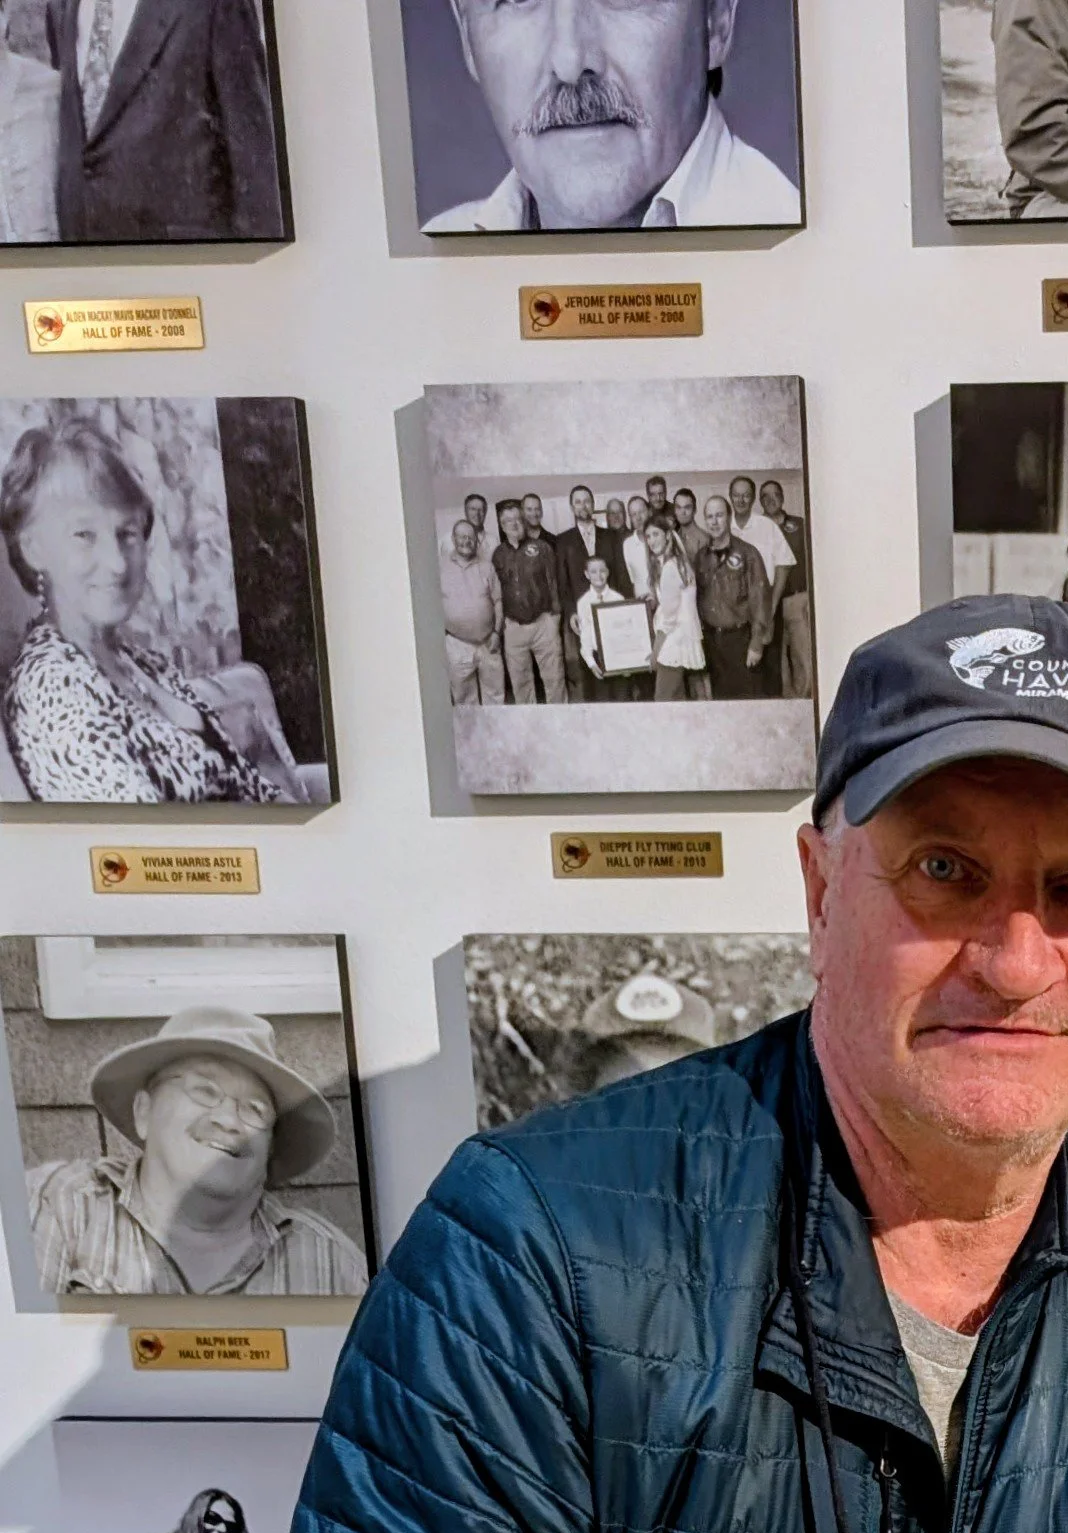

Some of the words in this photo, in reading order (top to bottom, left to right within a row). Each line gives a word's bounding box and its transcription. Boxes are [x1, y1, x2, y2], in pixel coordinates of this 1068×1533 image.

[565, 296, 606, 308] JEROME
[609, 295, 651, 307] FRANCIS
[655, 294, 697, 306] MOLLOY
[579, 312, 605, 325] HALL
[608, 312, 620, 324] OF
[624, 312, 651, 323] FAME
[82, 327, 105, 339] HALL
[110, 326, 122, 338] OF
[126, 325, 151, 338] FAME
[162, 324, 185, 337] 2008
[600, 841, 633, 853] DIEPPE
[636, 841, 652, 853] FLY
[655, 841, 684, 853] TYING
[686, 841, 711, 852] CLUB
[142, 856, 174, 868] VIVIAN
[175, 856, 211, 868] HARRIS
[214, 857, 242, 868] ASTLE
[606, 856, 631, 868] HALL
[634, 856, 646, 868] OF
[650, 856, 674, 867] FAME
[145, 872, 169, 883] HALL
[172, 872, 183, 883] OF
[186, 872, 211, 883] FAME
[220, 871, 242, 883] 2013
[179, 1350, 201, 1360] HALL
[203, 1350, 215, 1360] OF
[218, 1350, 241, 1360] FAME
